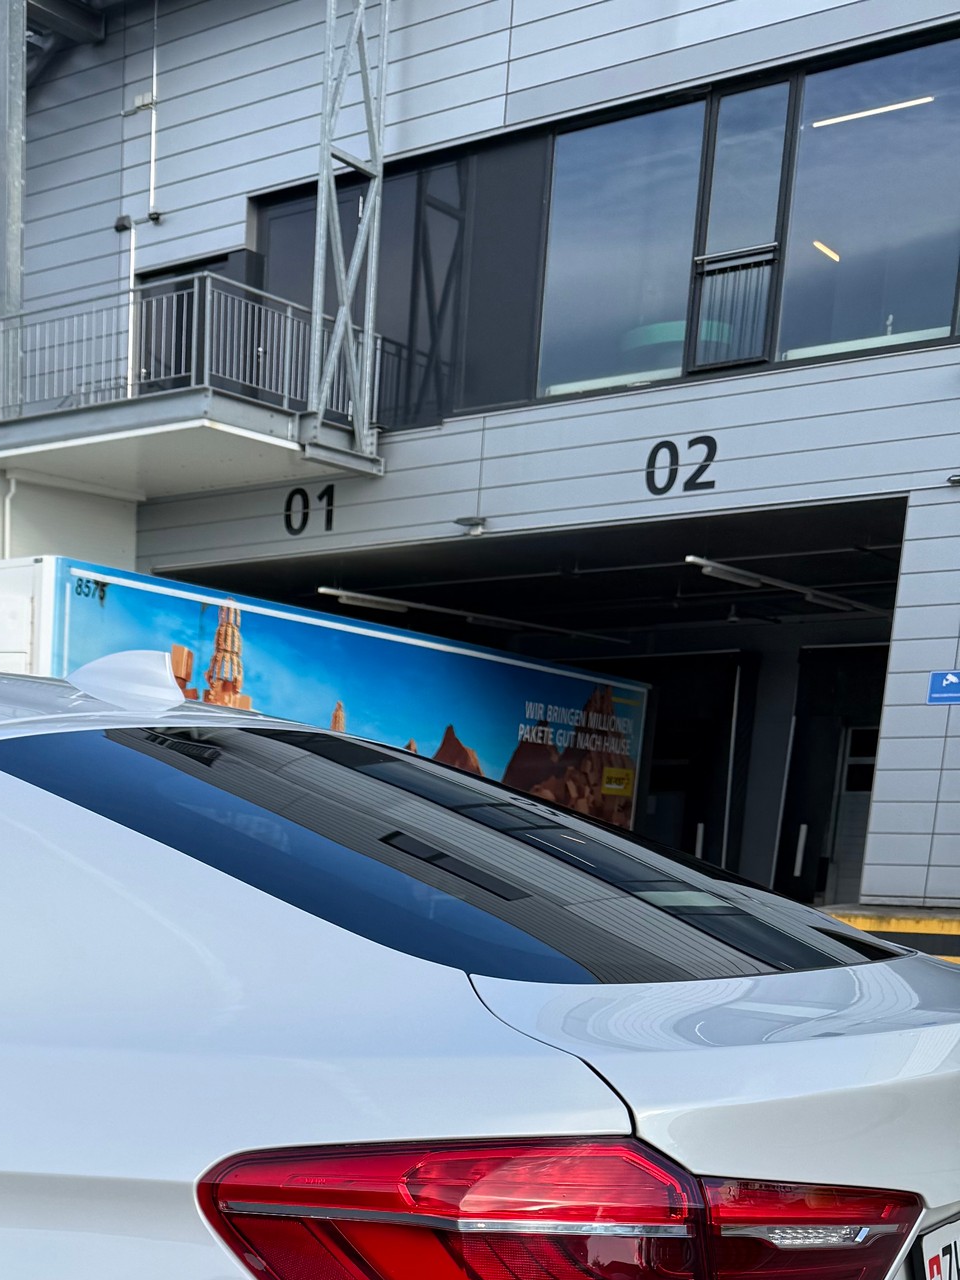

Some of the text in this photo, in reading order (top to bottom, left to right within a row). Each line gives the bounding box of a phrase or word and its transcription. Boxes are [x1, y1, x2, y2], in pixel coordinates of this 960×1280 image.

[645, 435, 717, 496] 02
[284, 484, 334, 536] 01
[525, 701, 544, 720] WIR
[546, 705, 586, 727] BRINGEN
[518, 723, 631, 755] PAKETE GUT NACH HAUSE
